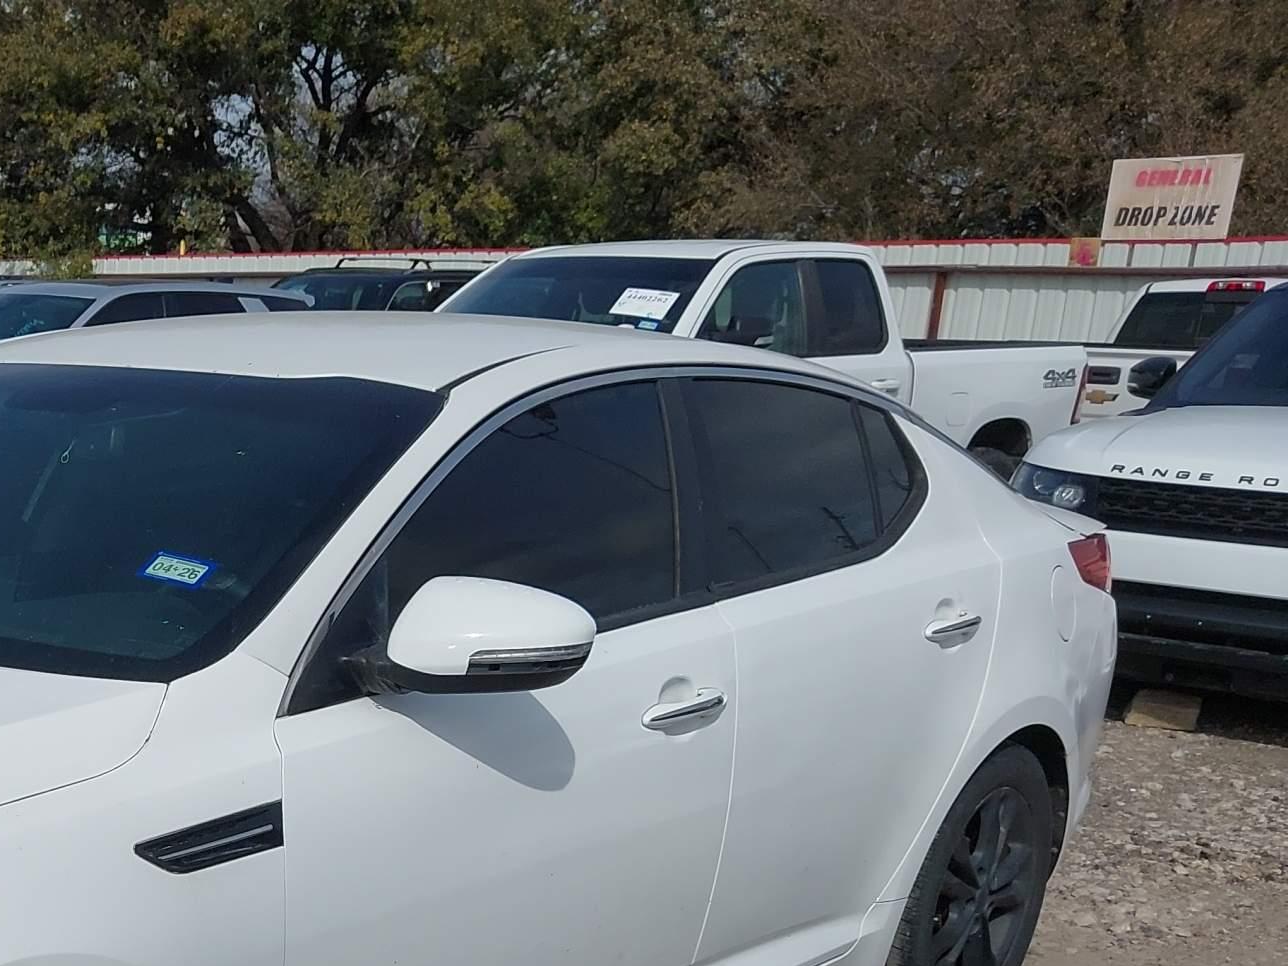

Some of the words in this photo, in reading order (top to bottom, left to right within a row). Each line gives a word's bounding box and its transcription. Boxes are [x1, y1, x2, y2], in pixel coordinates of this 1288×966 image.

[1114, 207, 1167, 226] DROP
[1042, 367, 1077, 382] 4x4
[1110, 464, 1214, 482] RANGE
